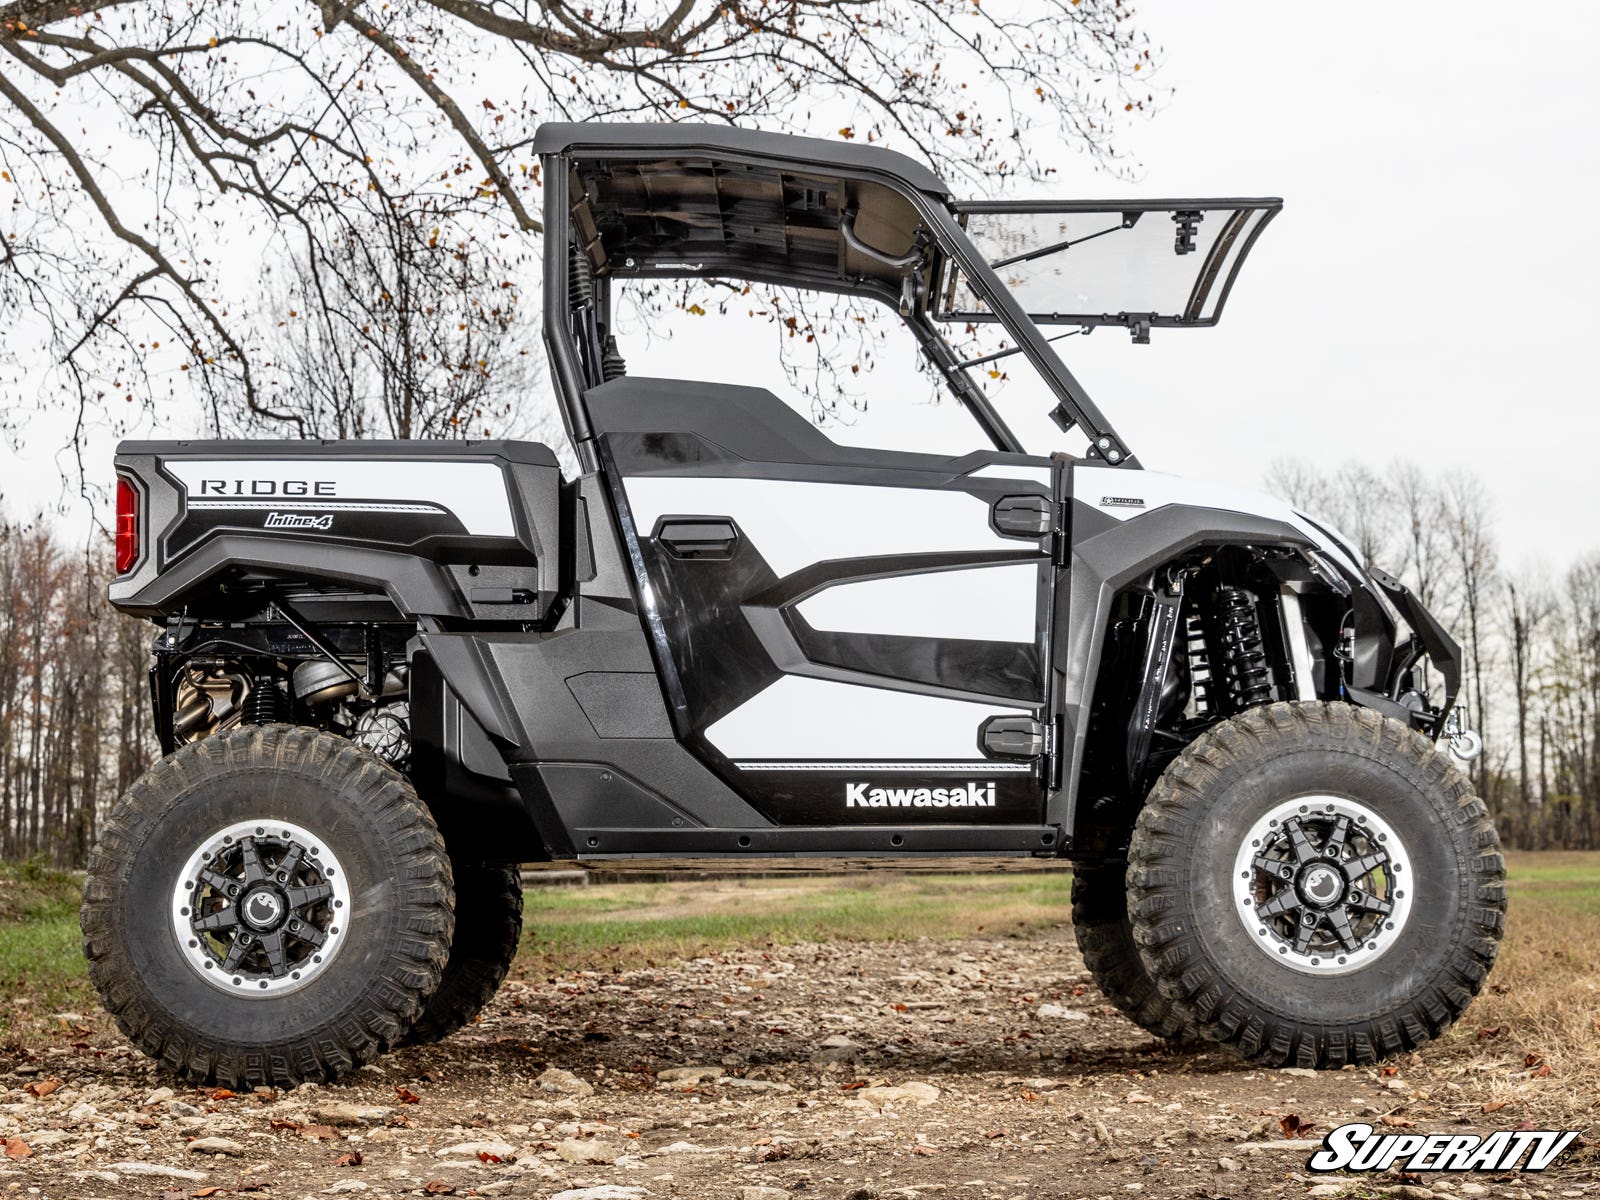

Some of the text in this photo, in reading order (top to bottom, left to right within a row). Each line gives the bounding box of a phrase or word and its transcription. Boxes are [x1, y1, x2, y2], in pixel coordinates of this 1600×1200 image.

[201, 480, 336, 496] RIDGE
[264, 512, 334, 530] Inline-4
[846, 782, 996, 807] Kawasaki
